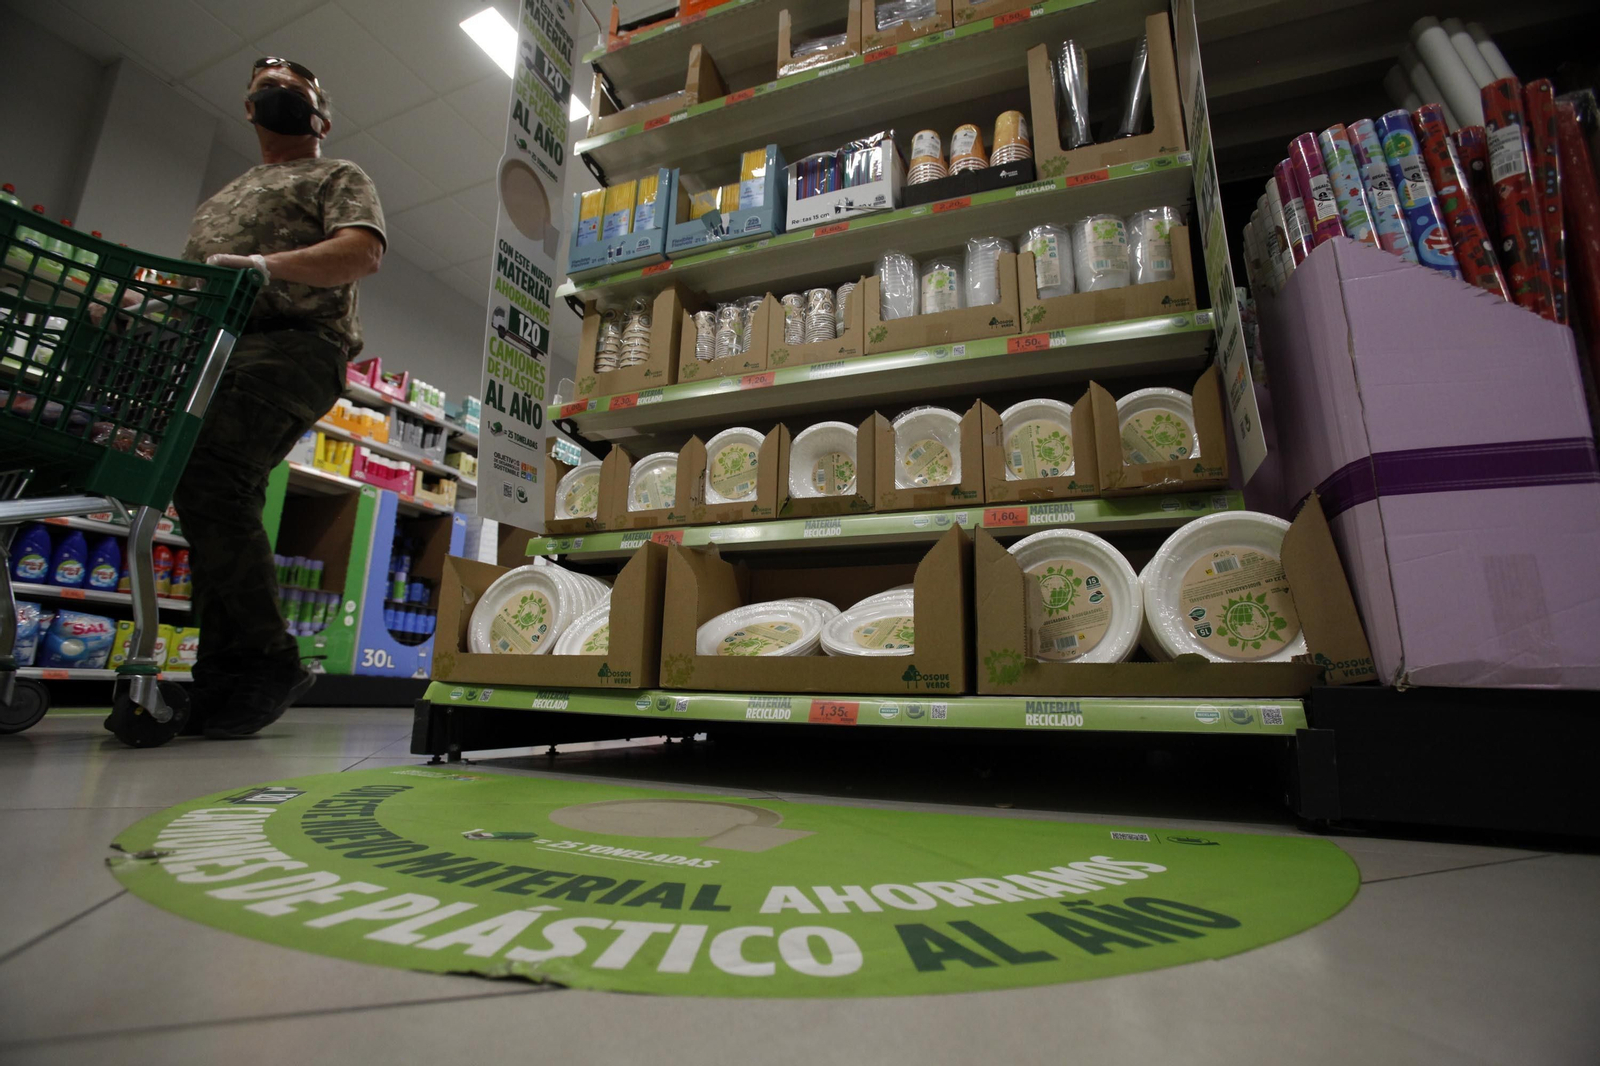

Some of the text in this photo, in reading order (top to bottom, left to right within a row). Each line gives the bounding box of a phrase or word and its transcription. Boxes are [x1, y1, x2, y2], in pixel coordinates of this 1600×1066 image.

[543, 56, 563, 94] 120
[515, 81, 527, 102] DE
[518, 63, 567, 129] CAMIONES
[513, 99, 564, 167] AL AÑO
[1015, 184, 1057, 197] RECICLADO
[499, 238, 553, 288] CON ESTE NUEVO
[497, 252, 551, 309] MATERIAL
[494, 276, 551, 326] AHORRAMOS
[519, 313, 541, 347] 120
[488, 336, 546, 384] CAMIONES
[487, 357, 545, 401] DE PLÁSTICO
[484, 379, 543, 430] AL AÑO
[636, 394, 664, 406] ECICLADO
[508, 429, 515, 440] 25
[1029, 502, 1075, 515] MATERIAL
[804, 518, 842, 530] MATERIAL
[1029, 513, 1076, 525] RECICLADO
[622, 531, 653, 542] MATERIAL
[803, 527, 842, 538] RECICLADO
[1088, 577, 1097, 585] 15
[1199, 628, 1211, 638] 15
[360, 648, 396, 669] 30L
[1325, 657, 1371, 671] BOSQUE
[913, 671, 950, 682] BOSQUE
[1342, 666, 1375, 677] VERDE
[614, 677, 632, 685] VERDE
[926, 680, 951, 690] VERDE
[535, 690, 572, 700] MATERIAL
[532, 699, 569, 710] RECICLADO
[747, 697, 792, 709] MATERIAL
[1025, 700, 1083, 714] MATERIAL
[745, 707, 791, 720] RECICLADO
[1025, 712, 1084, 727] RECICLADO
[549, 840, 582, 852] 25
[582, 843, 720, 869] TONELADAS
[372, 851, 732, 913] MATERIAL
[758, 855, 1168, 914] AHORRAMOS
[152, 806, 1242, 978] CAMIONES DE PLÁSTICO AL AÑO
